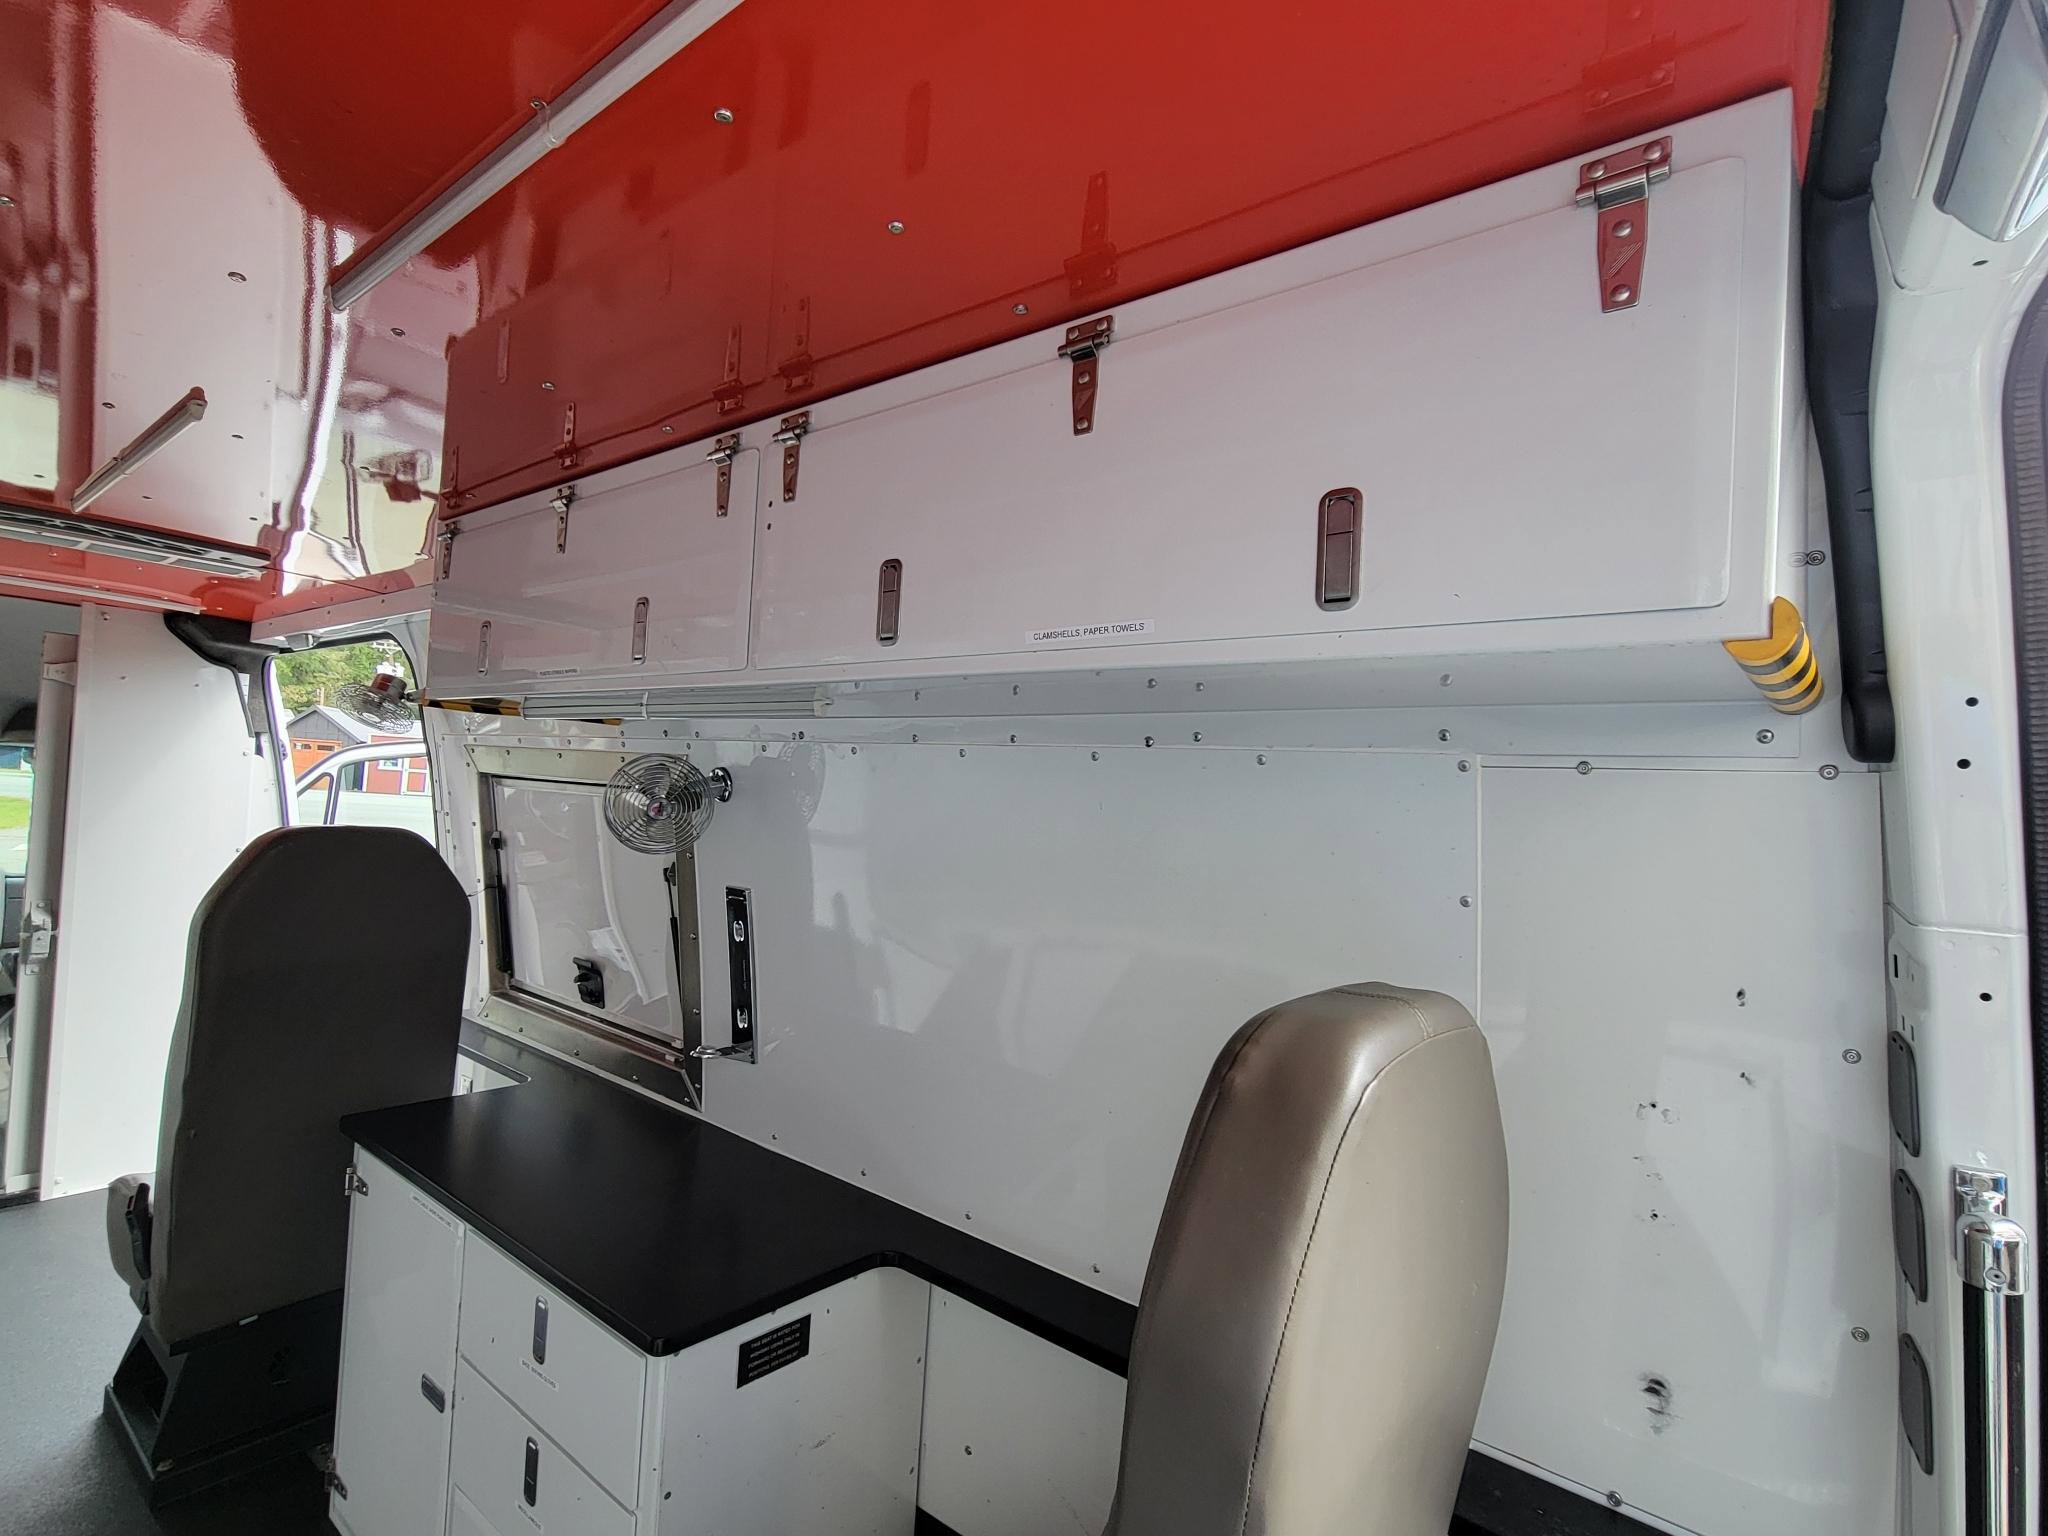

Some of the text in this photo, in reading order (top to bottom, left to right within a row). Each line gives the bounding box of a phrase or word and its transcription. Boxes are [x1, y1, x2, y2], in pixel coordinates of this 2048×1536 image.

[1033, 622, 1145, 641] CLAMSHELLS, PAPER TOWELS
